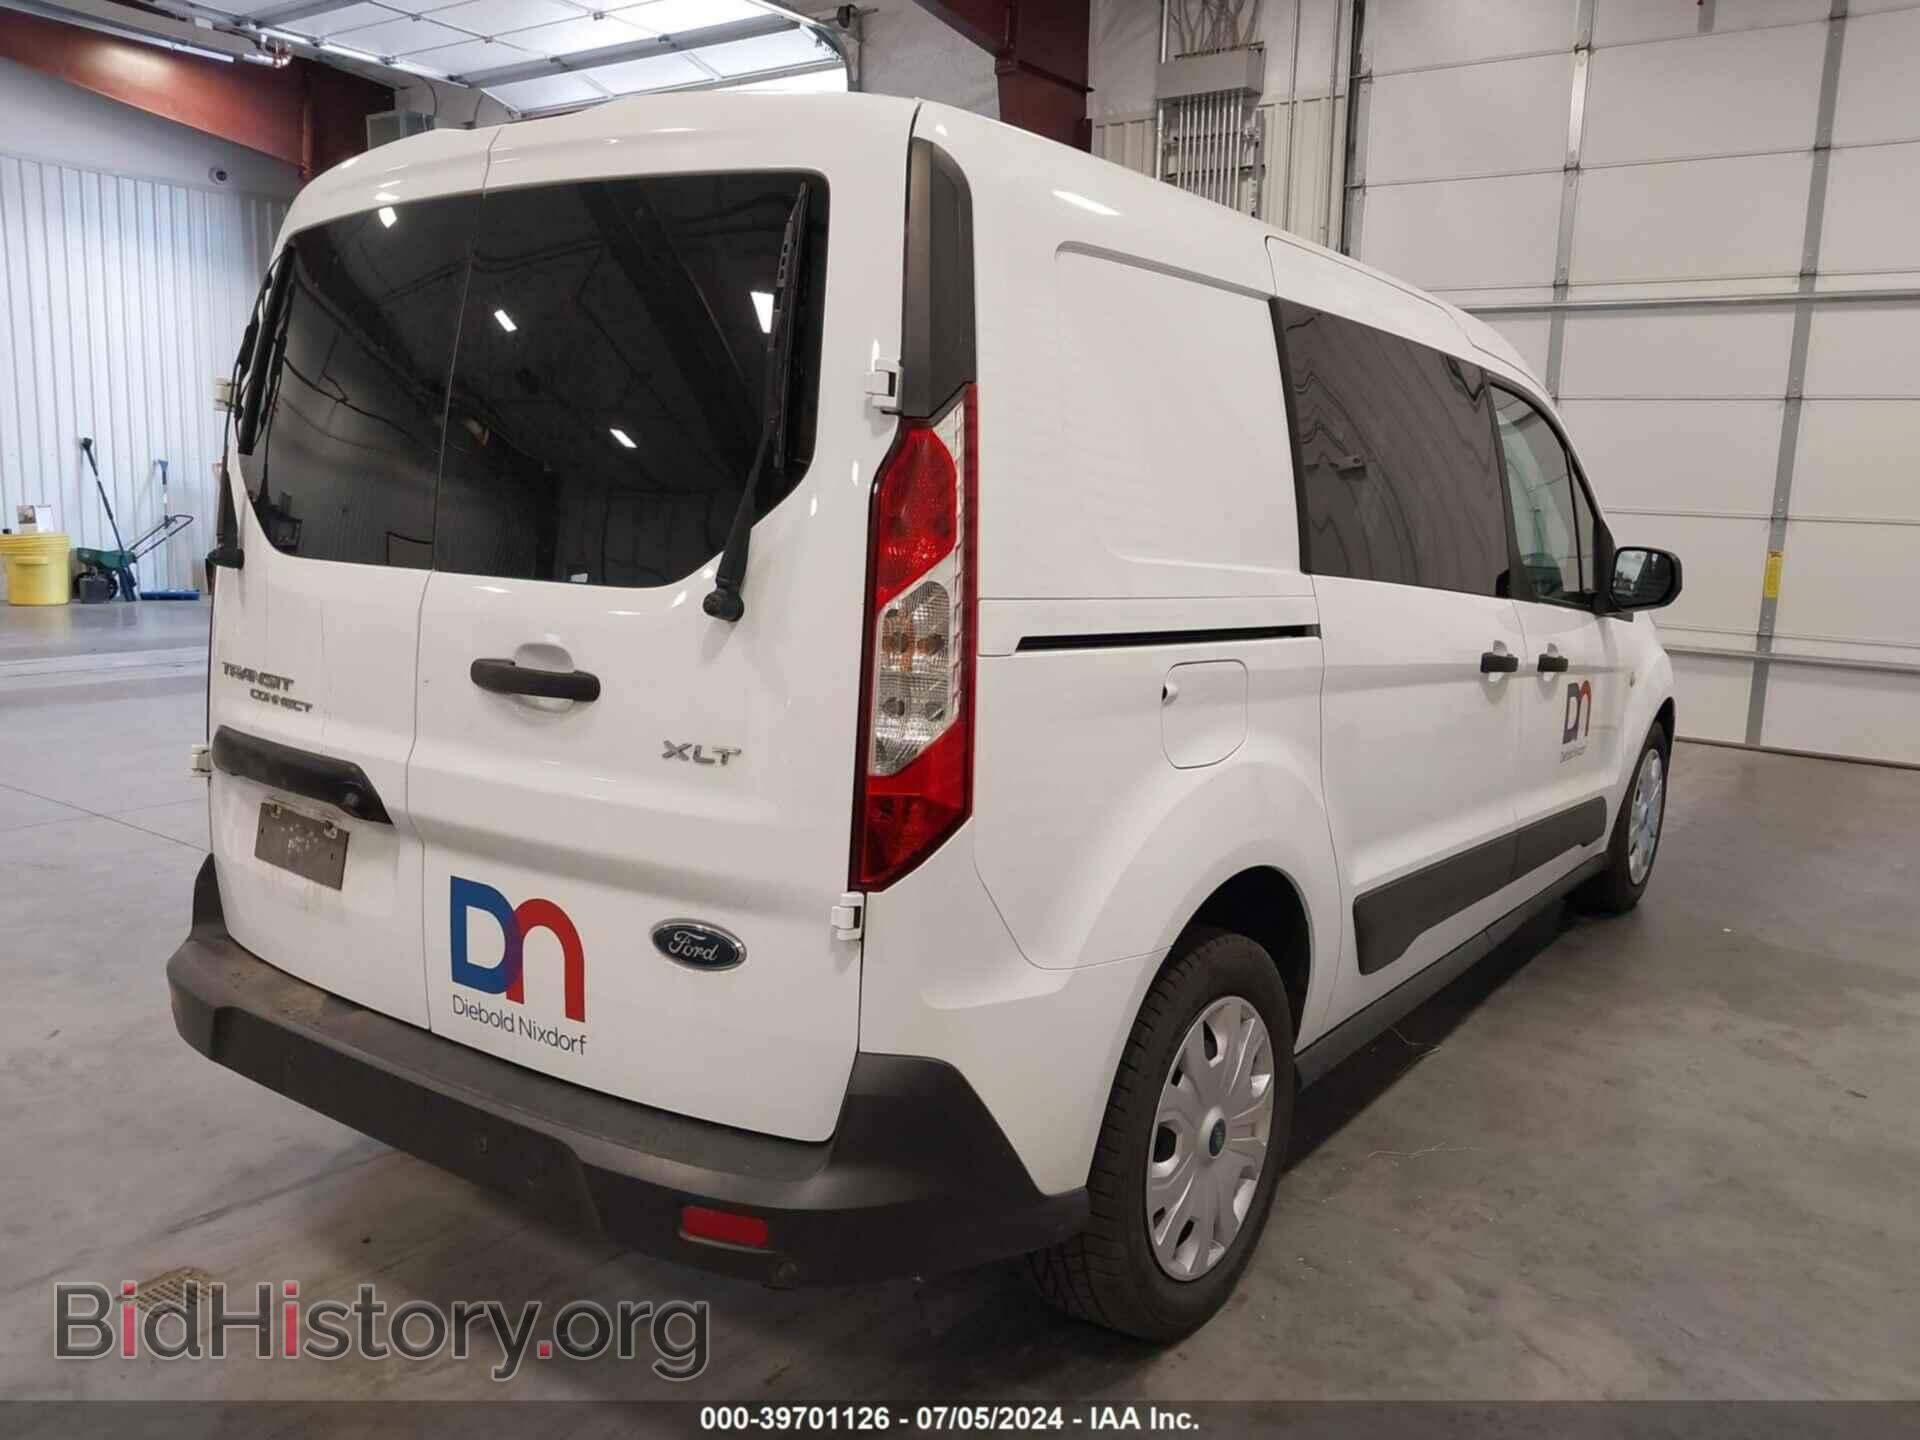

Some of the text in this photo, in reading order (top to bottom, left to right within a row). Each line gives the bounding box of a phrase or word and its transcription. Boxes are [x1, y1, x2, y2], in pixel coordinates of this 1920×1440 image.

[661, 740, 742, 766] XLT
[667, 930, 719, 962] Ford
[452, 994, 587, 1056] Diebold Nixdorf
